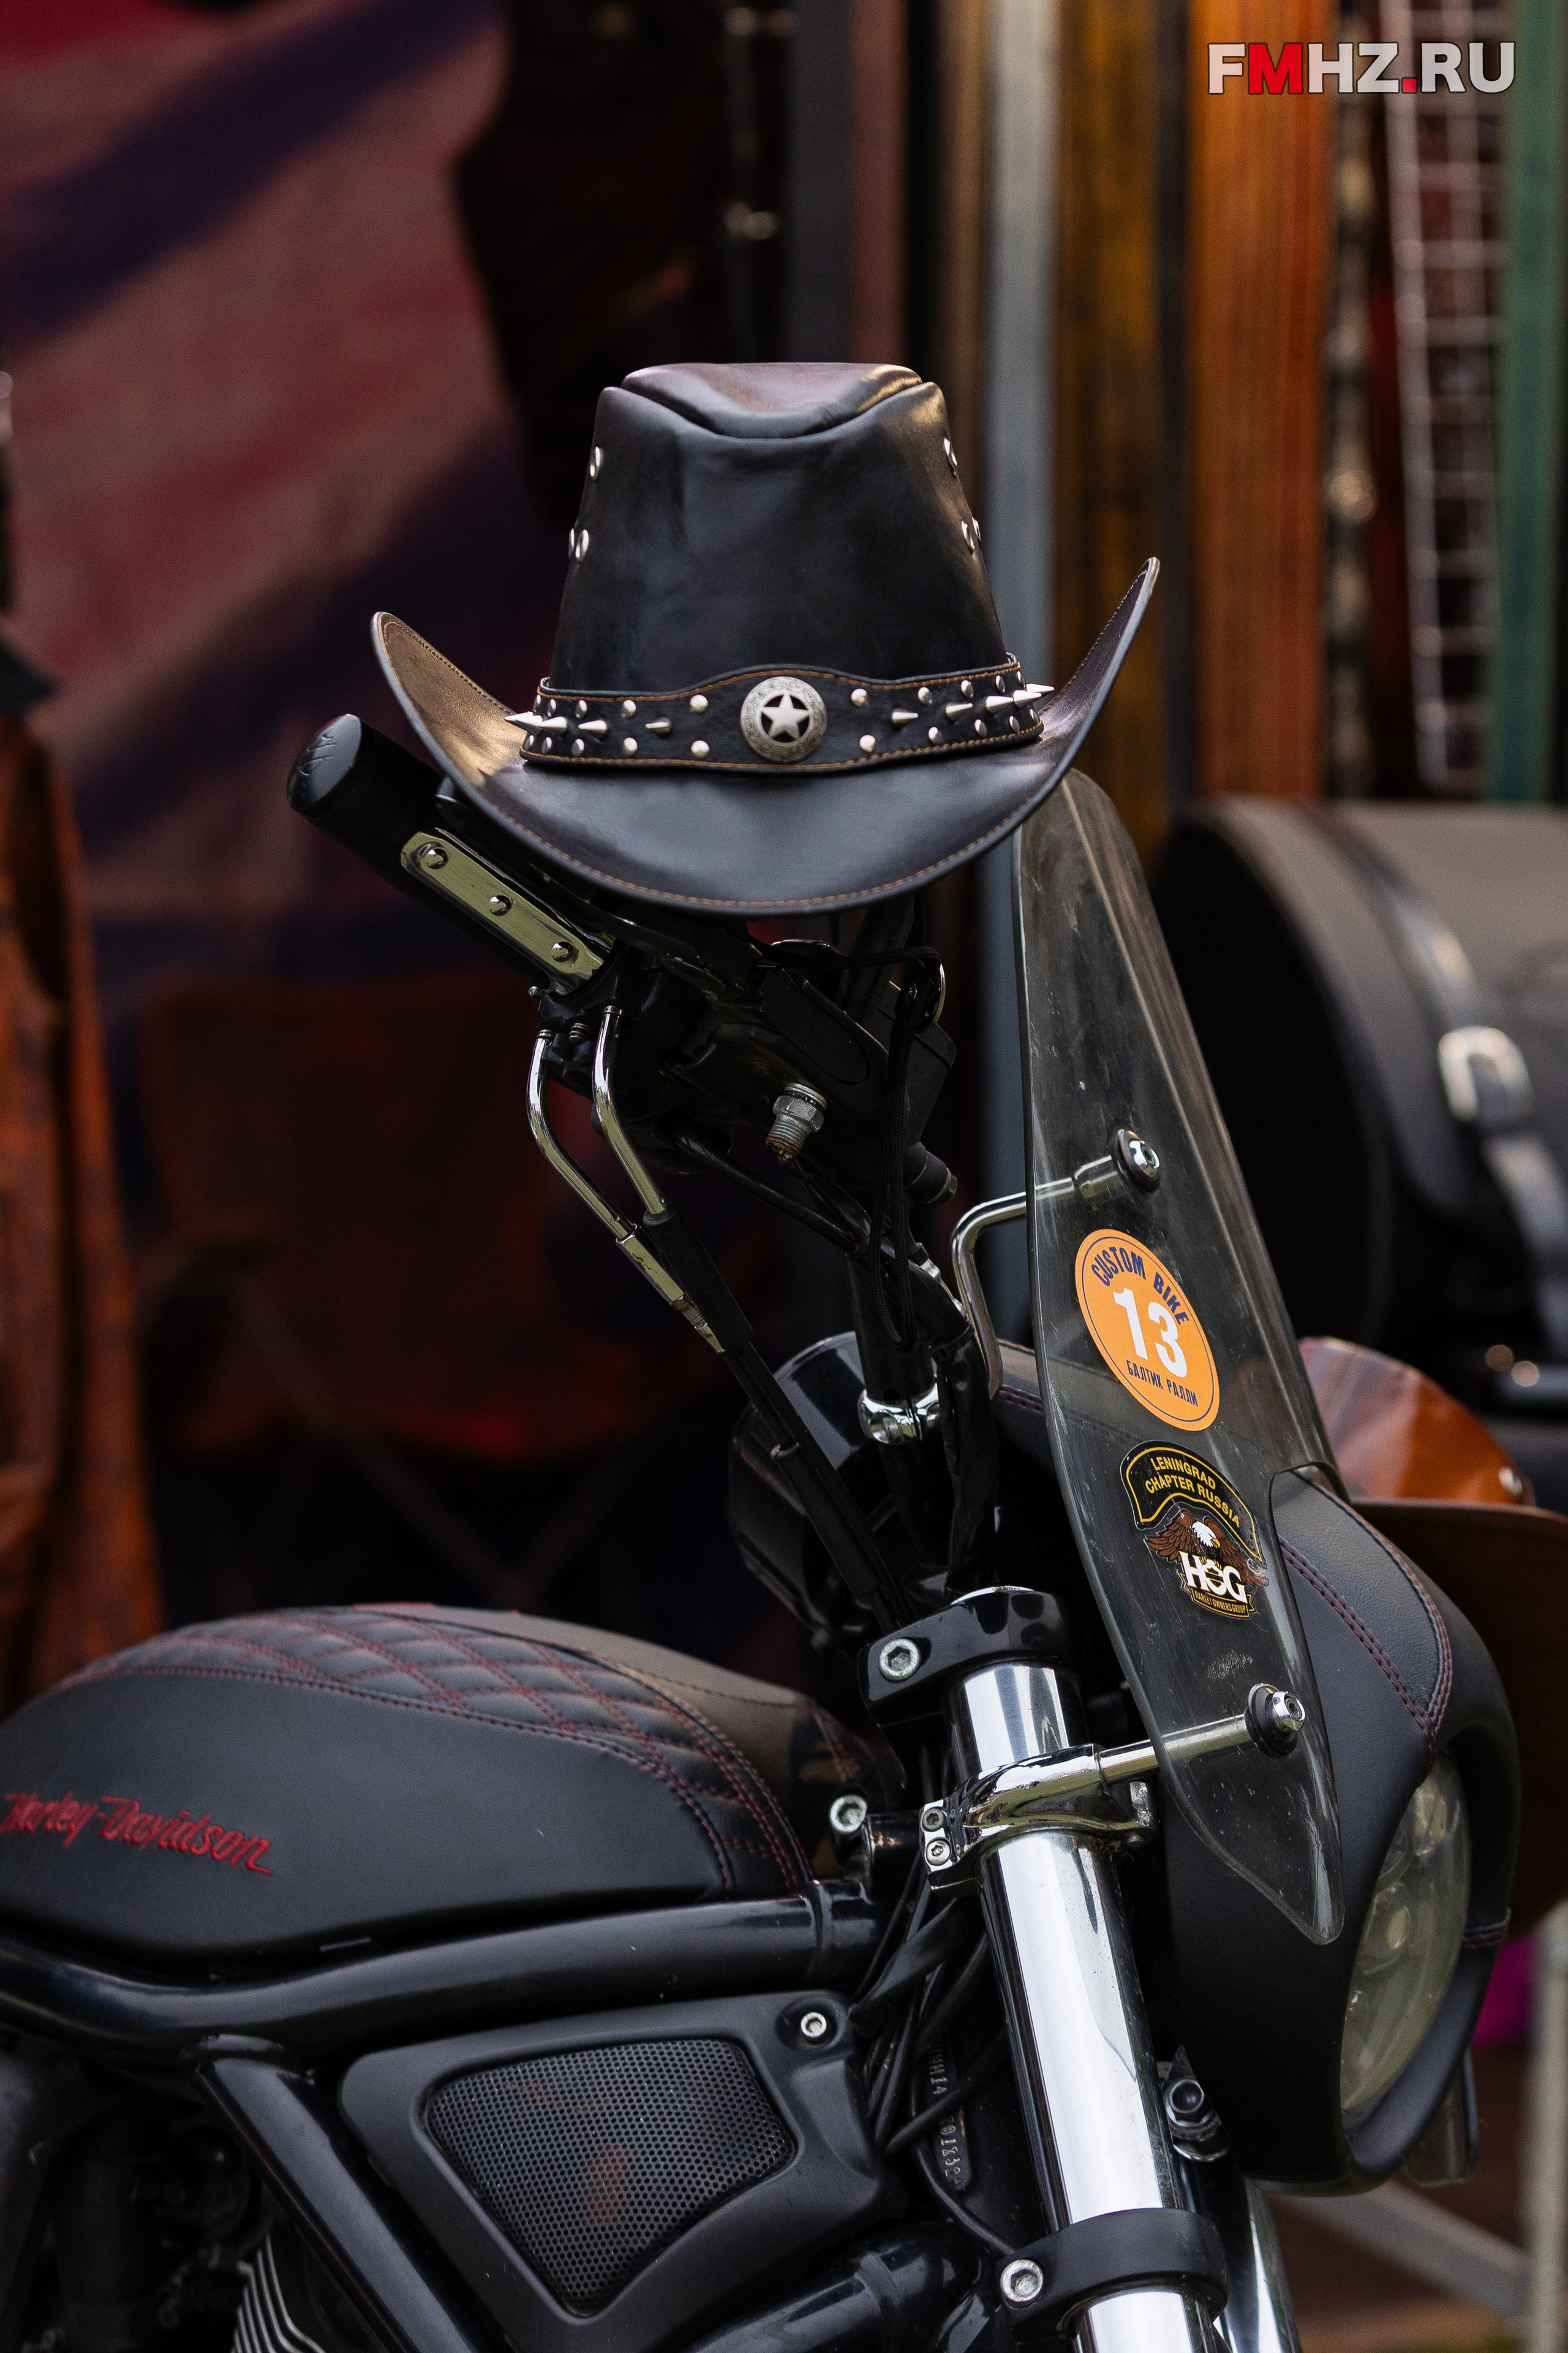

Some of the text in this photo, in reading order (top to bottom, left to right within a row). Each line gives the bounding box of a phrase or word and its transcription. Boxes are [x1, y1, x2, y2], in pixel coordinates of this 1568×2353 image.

[1091, 1246, 1189, 1324] CUSTOM BIKE
[1113, 1287, 1188, 1378] 13
[1126, 1360, 1199, 1407] БАЛТИК РАЛЛИ
[1150, 1456, 1216, 1490] LENINGRAD
[1145, 1475, 1240, 1528] CHAPTER RUSSIA
[1194, 1590, 1246, 1614] HARLEY OWNERS GROUP
